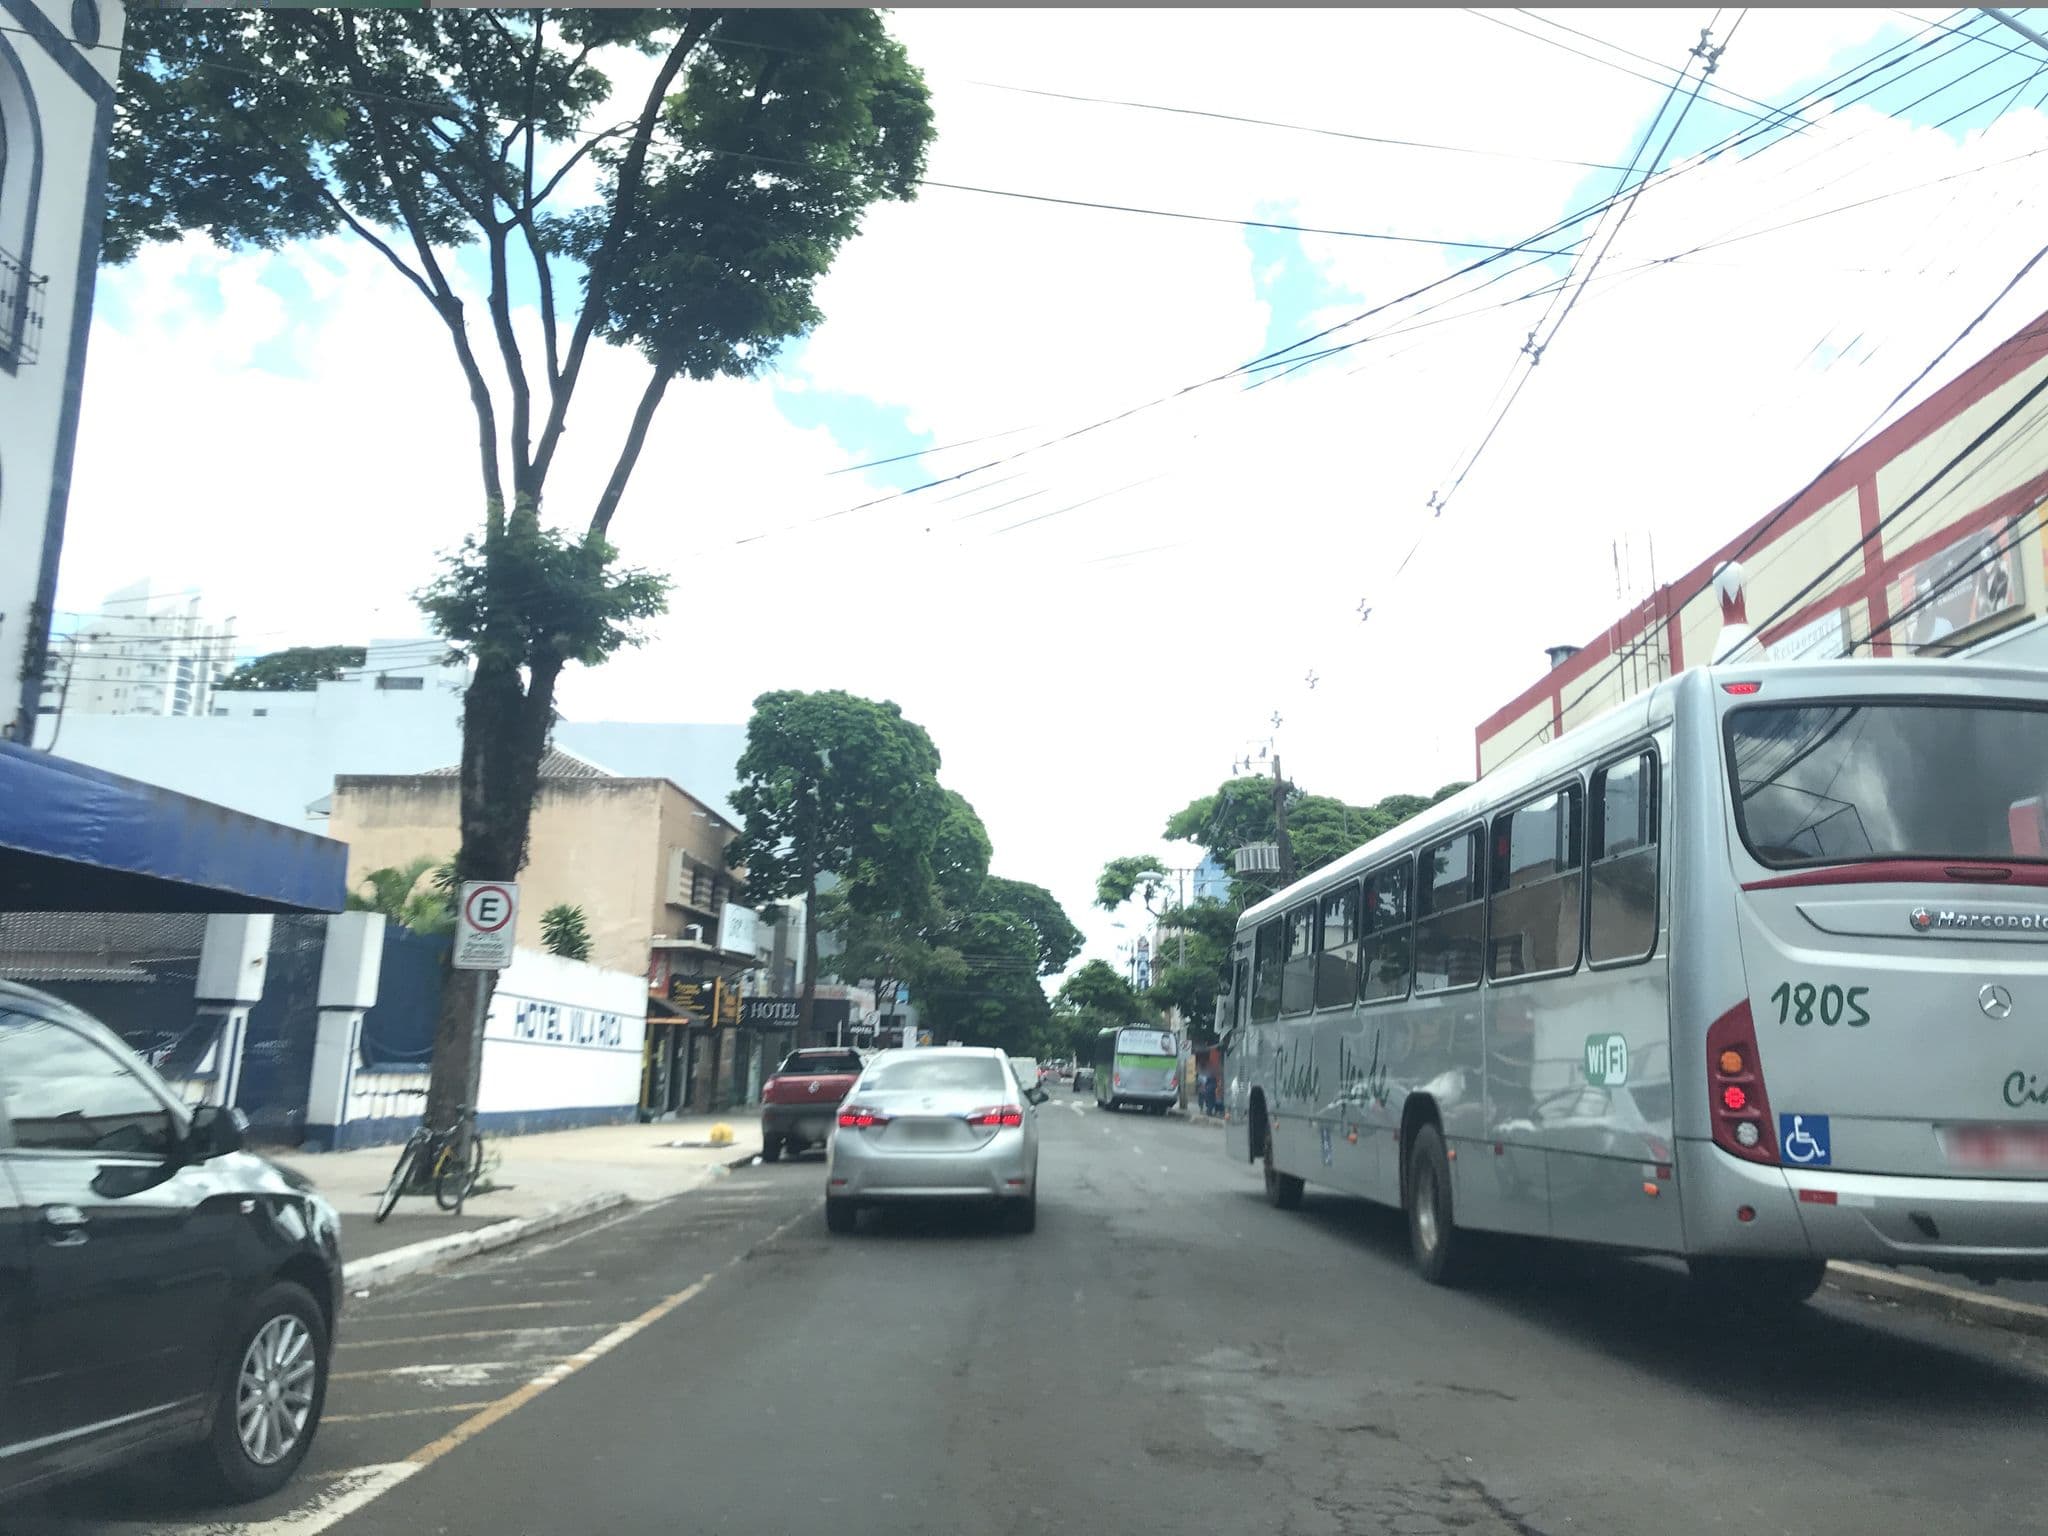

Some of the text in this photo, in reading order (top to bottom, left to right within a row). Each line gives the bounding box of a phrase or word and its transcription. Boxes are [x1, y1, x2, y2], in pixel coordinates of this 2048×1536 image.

[480, 898, 499, 921] E
[751, 1002, 801, 1019] HOTEL
[1771, 982, 1870, 1027] 1805
[514, 1001, 562, 1041] HOTEL
